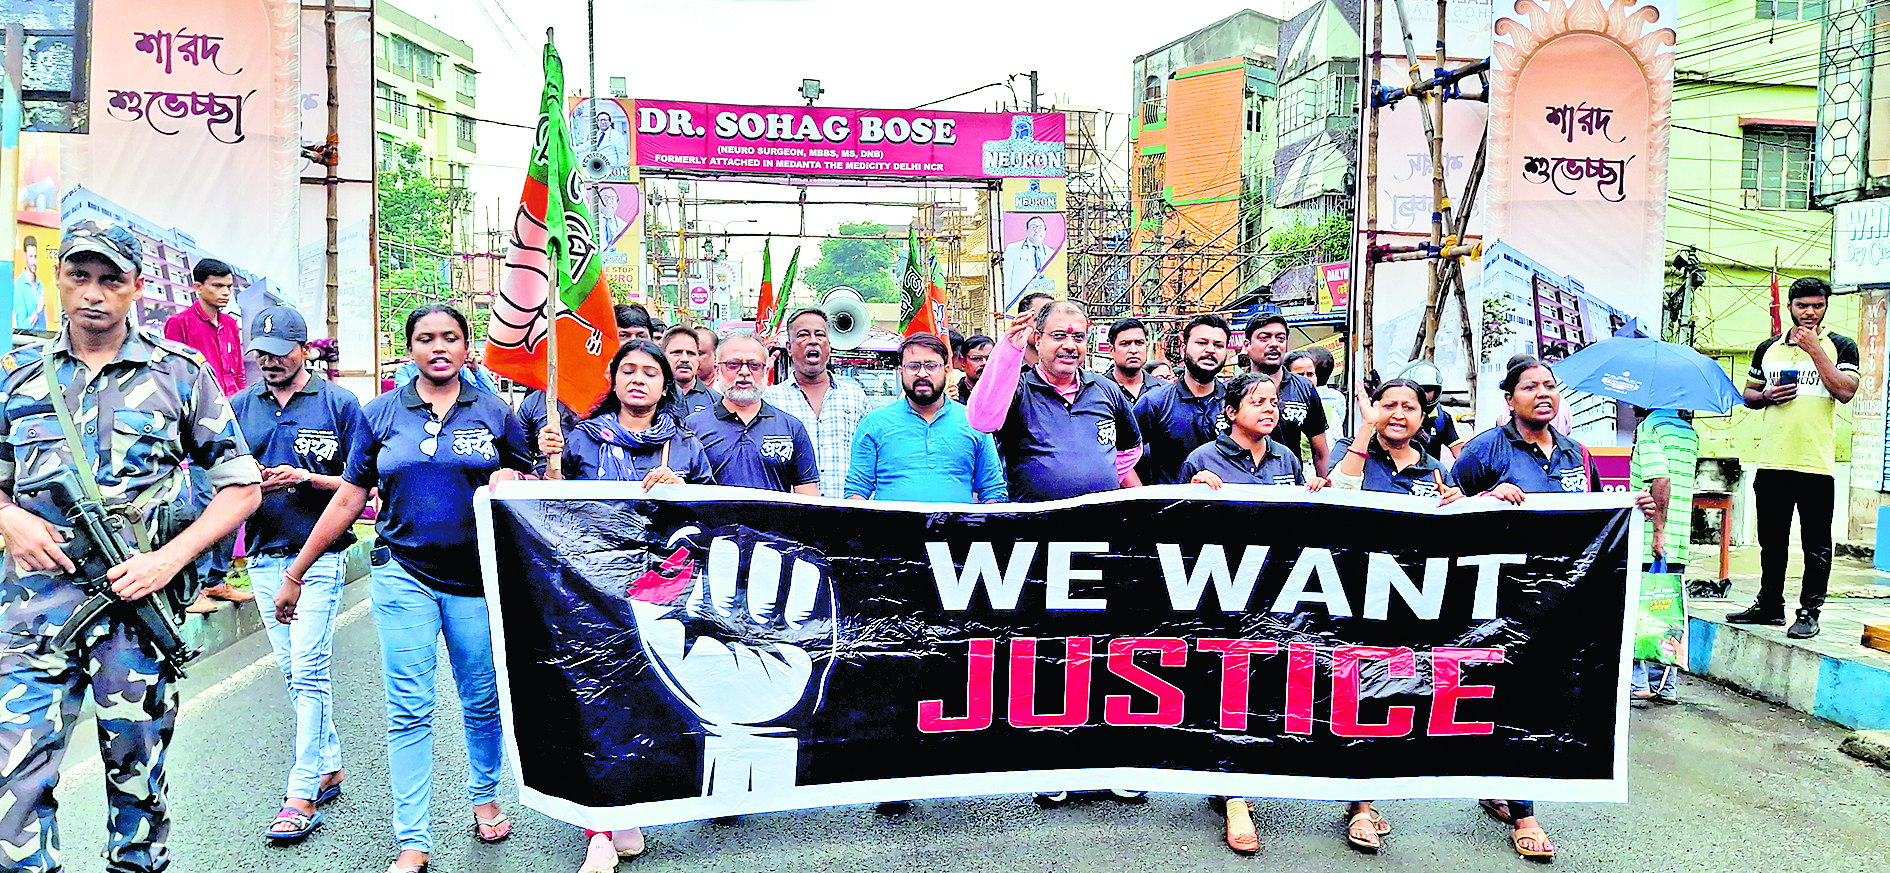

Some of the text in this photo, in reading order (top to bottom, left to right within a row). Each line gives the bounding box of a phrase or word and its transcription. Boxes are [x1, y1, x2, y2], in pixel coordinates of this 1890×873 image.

[133, 27, 243, 76] শারদ
[107, 88, 257, 145] শুভেচ্ছা
[637, 107, 957, 145] DR. SOHAG BOSE
[1545, 101, 1626, 143] শারদ
[654, 154, 944, 171] FORMERLY ATTACHED IN MEDANTA THE MEDICITY DELHI NCR
[717, 145, 884, 160] (NEURO SURGEON, MBBS, MS, DNB)
[985, 151, 1061, 169] NEURON
[1522, 154, 1636, 202] শুভেচ্ছা
[1015, 197, 1056, 207] NEURON
[1844, 243, 1866, 266] Dry
[924, 541, 1528, 621] WE WANT
[916, 636, 1506, 738] JUSTICE
